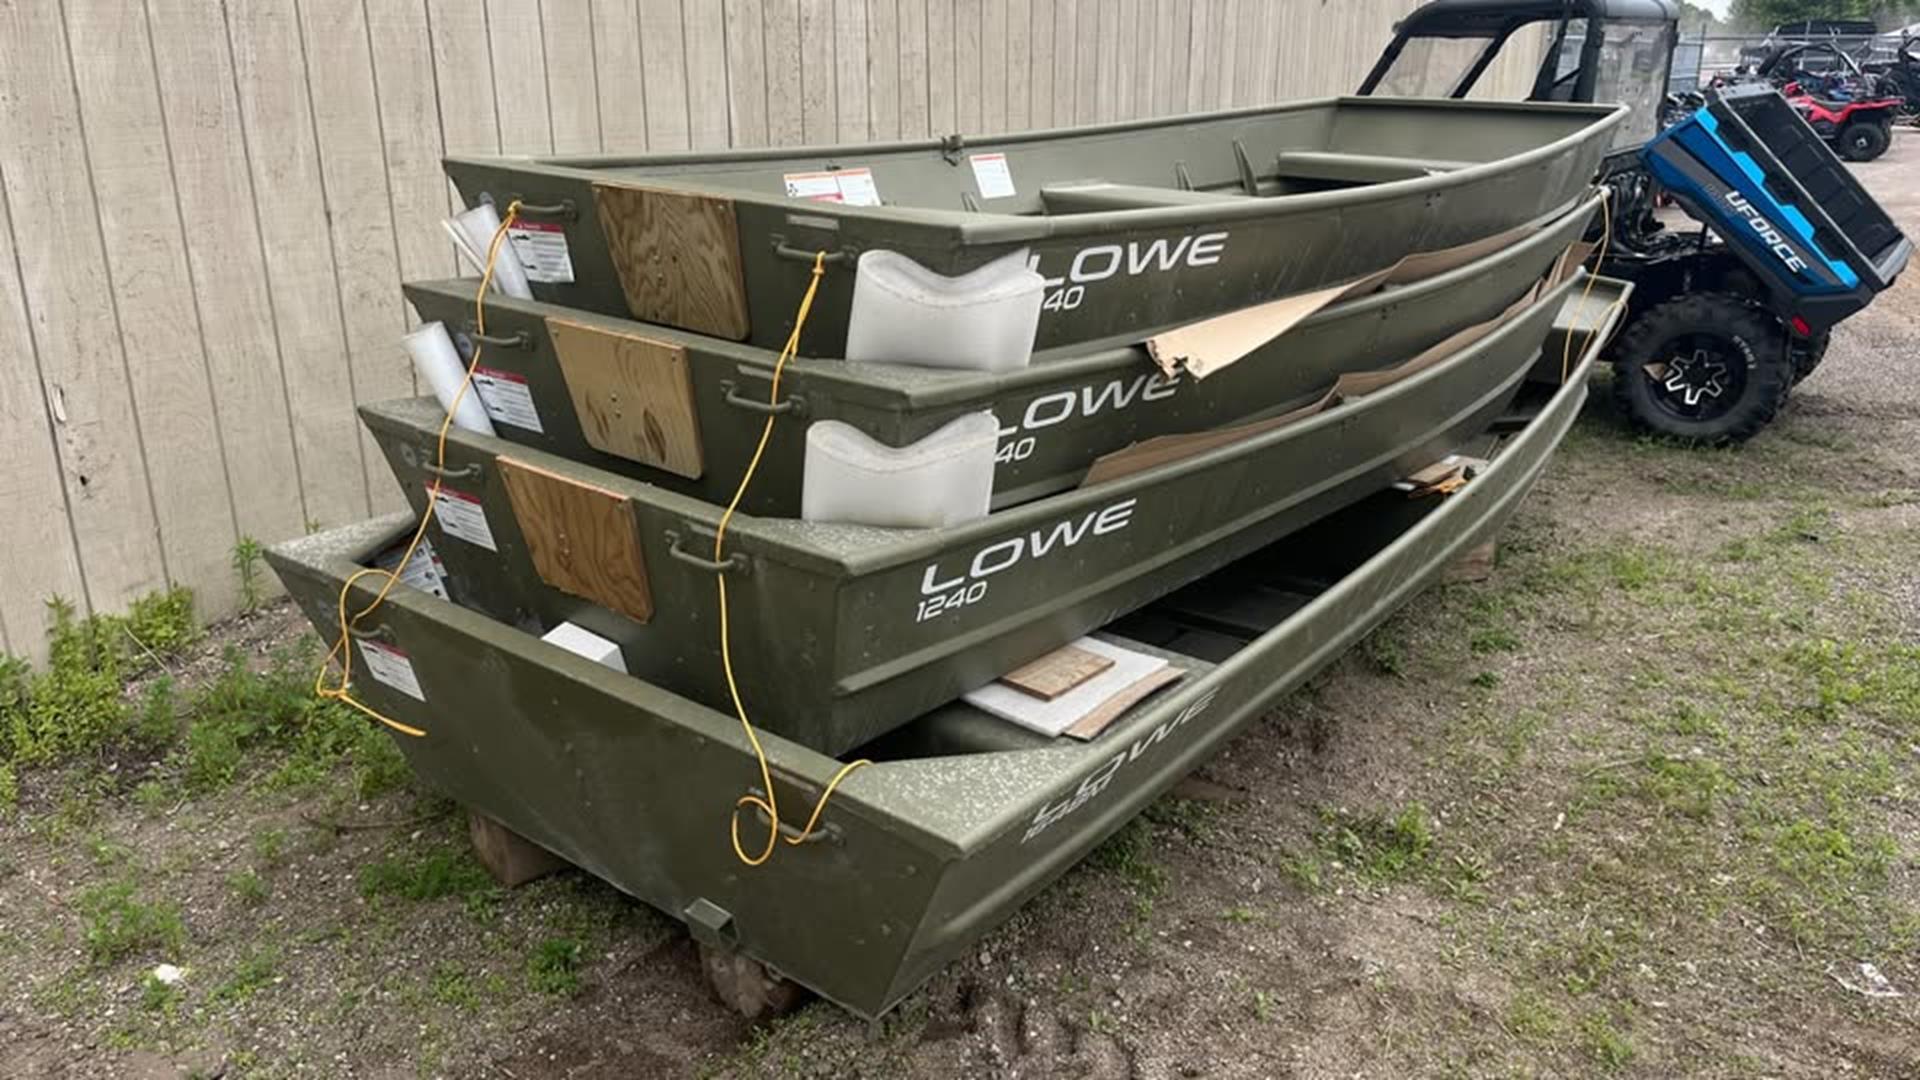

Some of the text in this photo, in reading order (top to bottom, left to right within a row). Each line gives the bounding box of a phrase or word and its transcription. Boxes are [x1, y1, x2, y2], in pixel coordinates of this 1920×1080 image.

[1725, 190, 1807, 273] UFORCE
[1043, 285, 1085, 312] 40
[995, 436, 1036, 463] 40
[921, 498, 1137, 595] LOWE
[916, 581, 988, 622] 1240
[1032, 686, 1220, 825] LOWE
